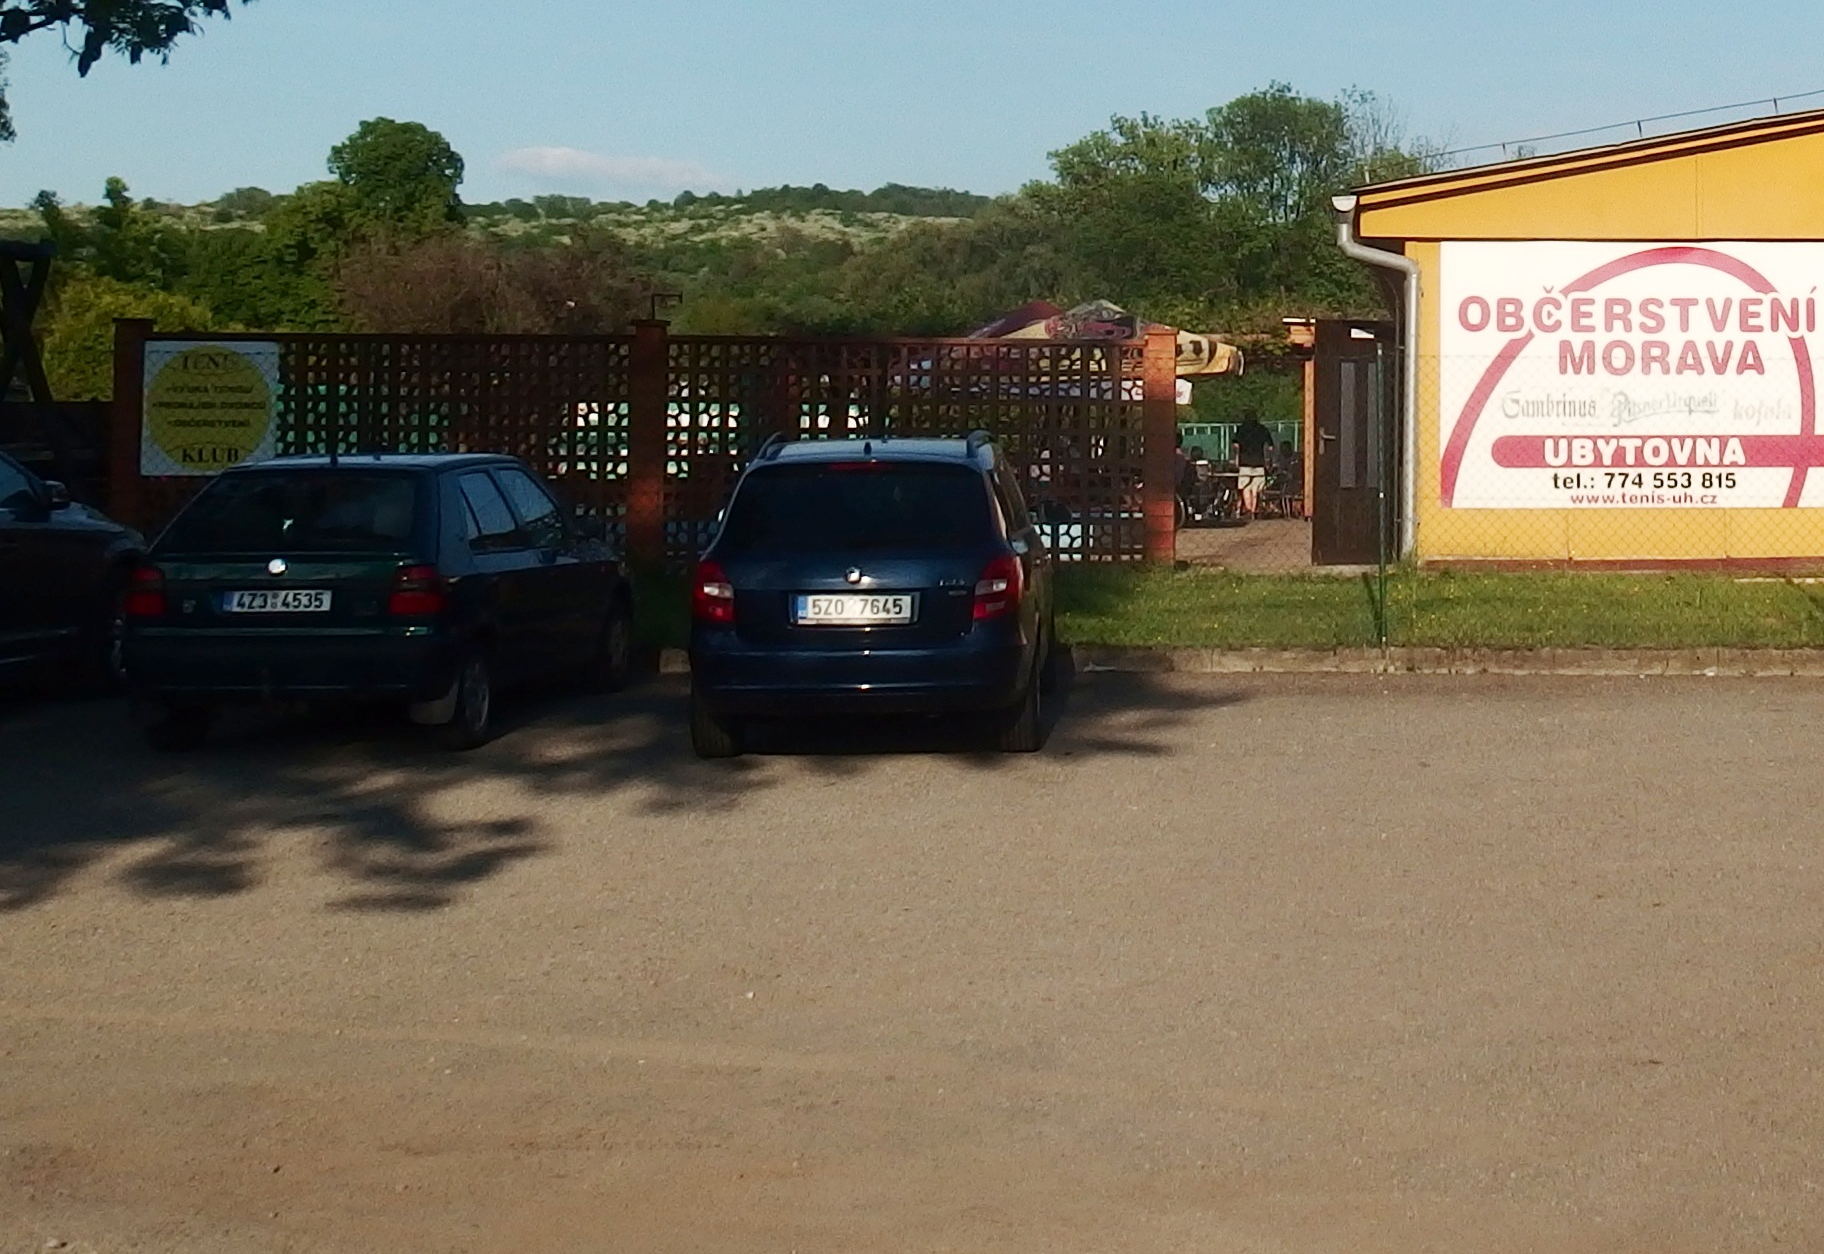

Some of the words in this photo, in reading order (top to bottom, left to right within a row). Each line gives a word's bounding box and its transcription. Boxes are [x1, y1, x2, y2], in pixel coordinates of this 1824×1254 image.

[1457, 286, 1818, 333] OBČERSTVENÍ
[1558, 339, 1766, 377] MORAVA
[1501, 391, 1597, 420] Gambrinus
[182, 447, 239, 463] KLUB
[1543, 436, 1747, 467] UBYTOVNA
[1552, 472, 1596, 489] tel.:
[1604, 472, 1644, 489] 774
[1652, 472, 1693, 489] 553
[1702, 472, 1737, 489] 815
[1570, 492, 1718, 505] www.tenis-uh.cz
[237, 592, 268, 609] 4Z3
[281, 592, 324, 609] 4535
[859, 598, 903, 616] 7645
